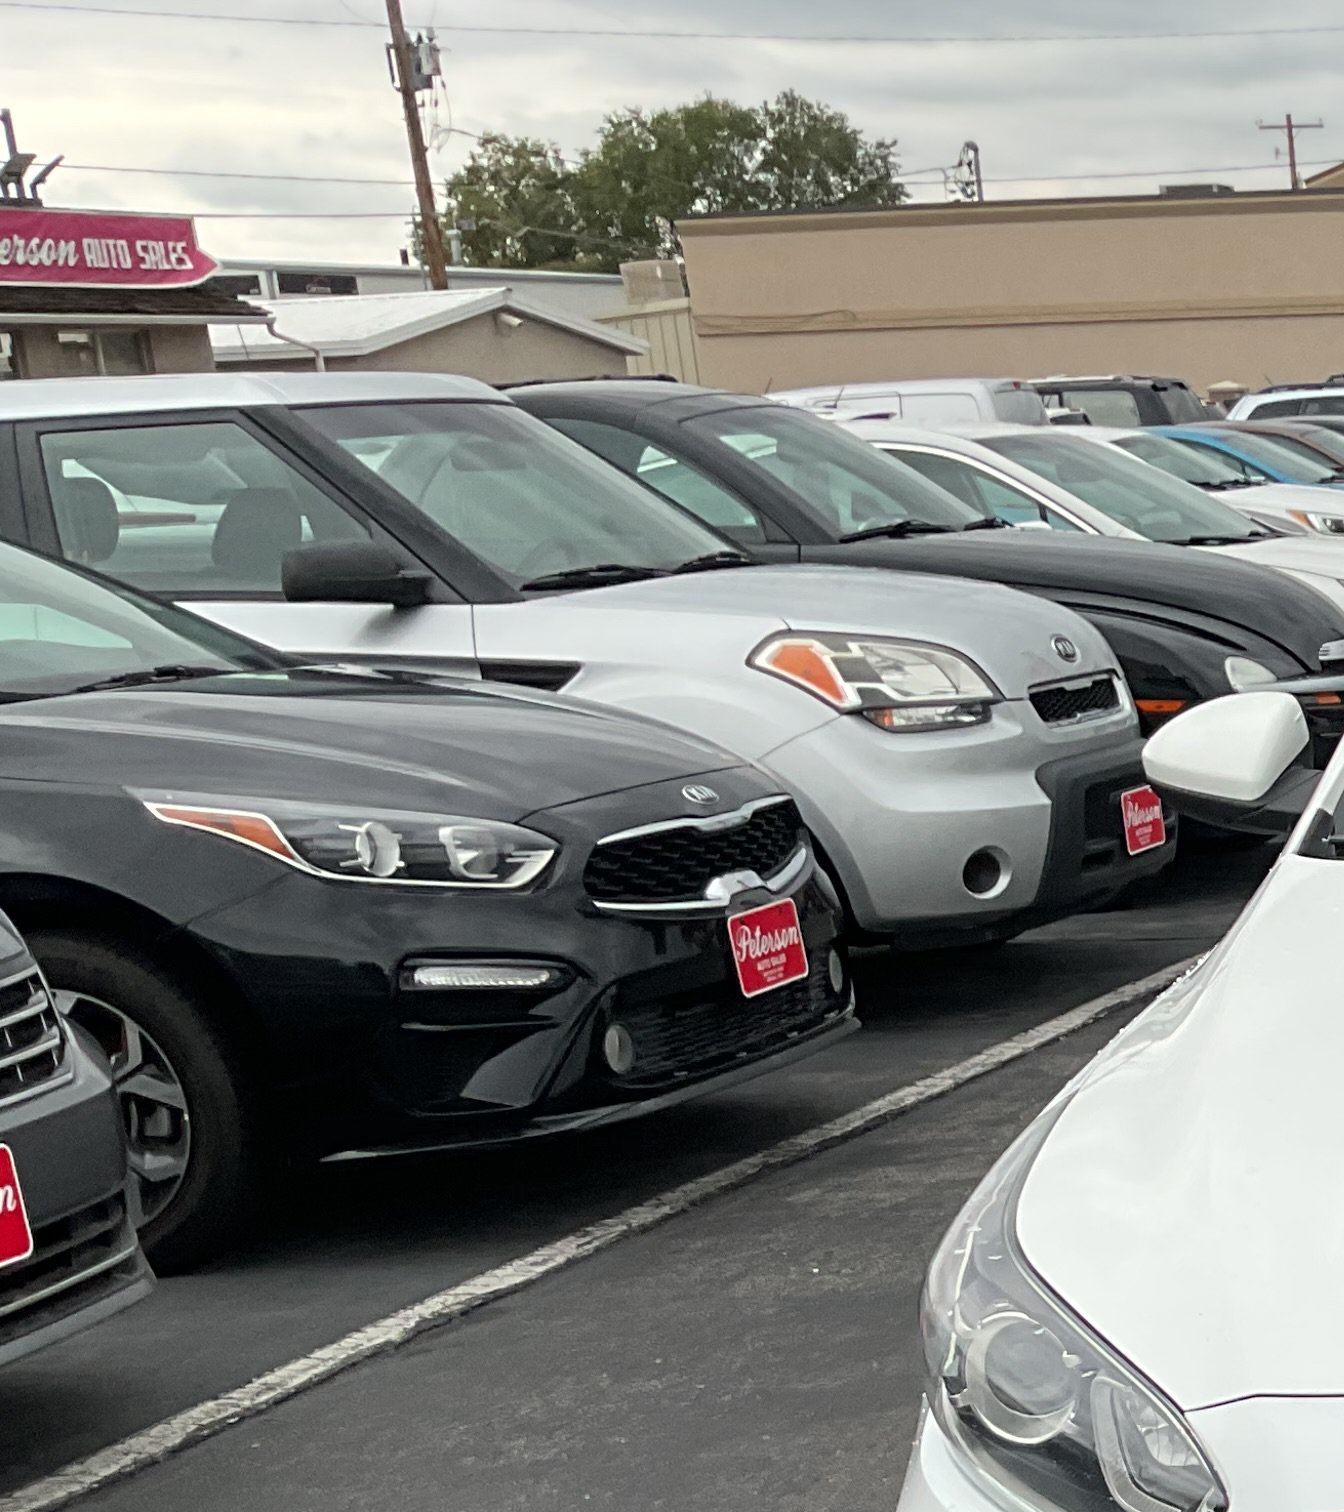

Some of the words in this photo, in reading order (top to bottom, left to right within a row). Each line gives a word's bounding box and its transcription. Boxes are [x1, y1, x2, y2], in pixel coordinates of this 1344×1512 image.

[82, 238, 132, 268] AUTO
[135, 240, 194, 270] SALES
[736, 924, 800, 963] Peterson
